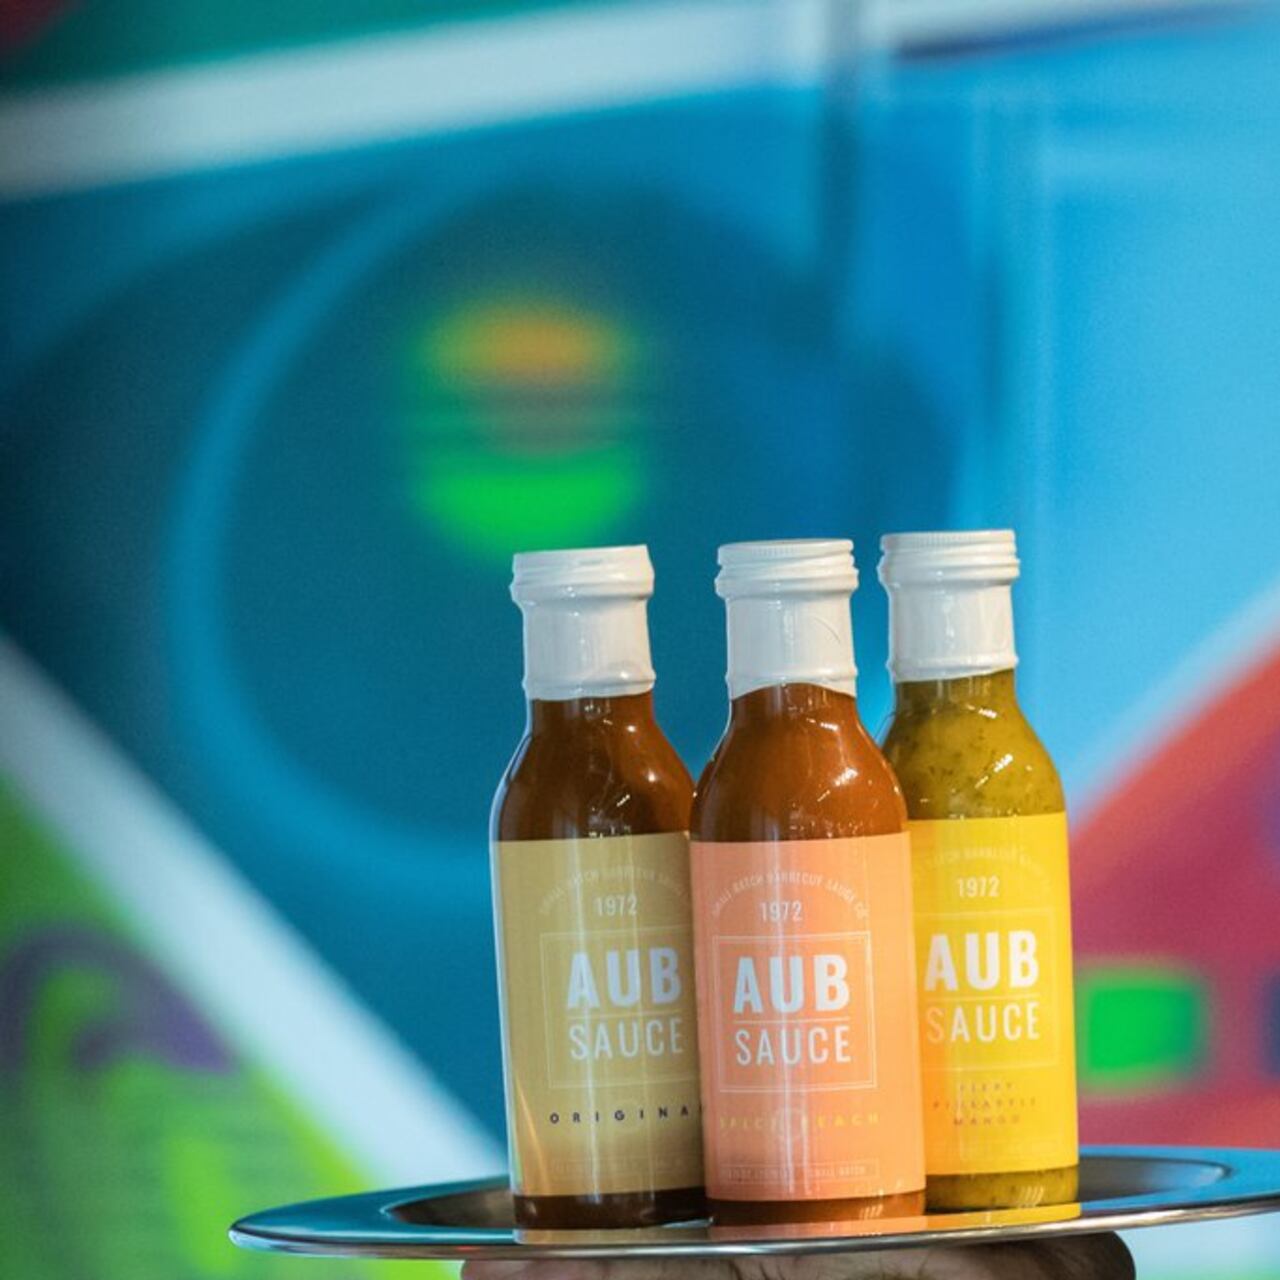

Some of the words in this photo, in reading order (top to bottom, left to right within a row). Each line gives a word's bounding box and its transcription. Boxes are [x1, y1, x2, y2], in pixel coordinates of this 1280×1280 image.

[593, 894, 638, 918] 1972
[958, 875, 1000, 898] 1972
[760, 901, 803, 923] 1972
[566, 947, 682, 1010] AUB
[924, 930, 1039, 991] AUB
[733, 954, 850, 1014] AUB
[569, 1018, 683, 1061] SAUCE
[926, 1002, 1040, 1044] SAUCE
[736, 1025, 851, 1067] SAUCE
